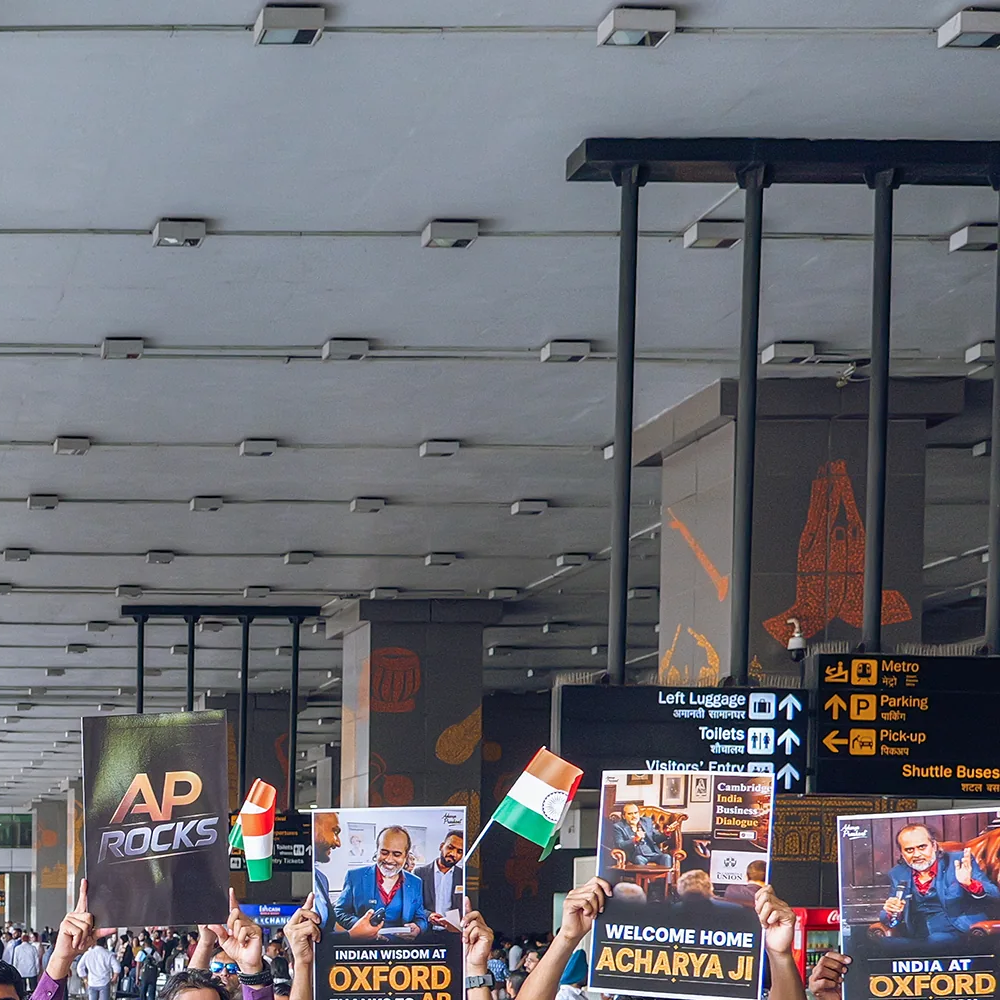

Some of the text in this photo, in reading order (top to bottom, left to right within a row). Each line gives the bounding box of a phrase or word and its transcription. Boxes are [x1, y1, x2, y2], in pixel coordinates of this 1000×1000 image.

[881, 659, 920, 673] Metro
[658, 691, 746, 708] Left Luggage
[880, 695, 929, 711] Parking
[698, 726, 745, 741] Toilets
[880, 729, 926, 744] Pick-up
[708, 761, 745, 773] Entry
[902, 764, 1000, 779] Shuttle Buses
[109, 770, 203, 824] AP
[716, 794, 743, 803] India
[716, 805, 758, 815] Business
[715, 816, 758, 828] Dialogue
[97, 817, 219, 864] ROCKS
[605, 923, 754, 948] WELCOME HOME
[335, 949, 447, 960] INDIAN WISDOM AT
[595, 946, 754, 981] ACHARYA JI
[892, 959, 972, 973] INDIA AT
[328, 965, 452, 992] OXFORD
[869, 973, 997, 998] OXFORD
